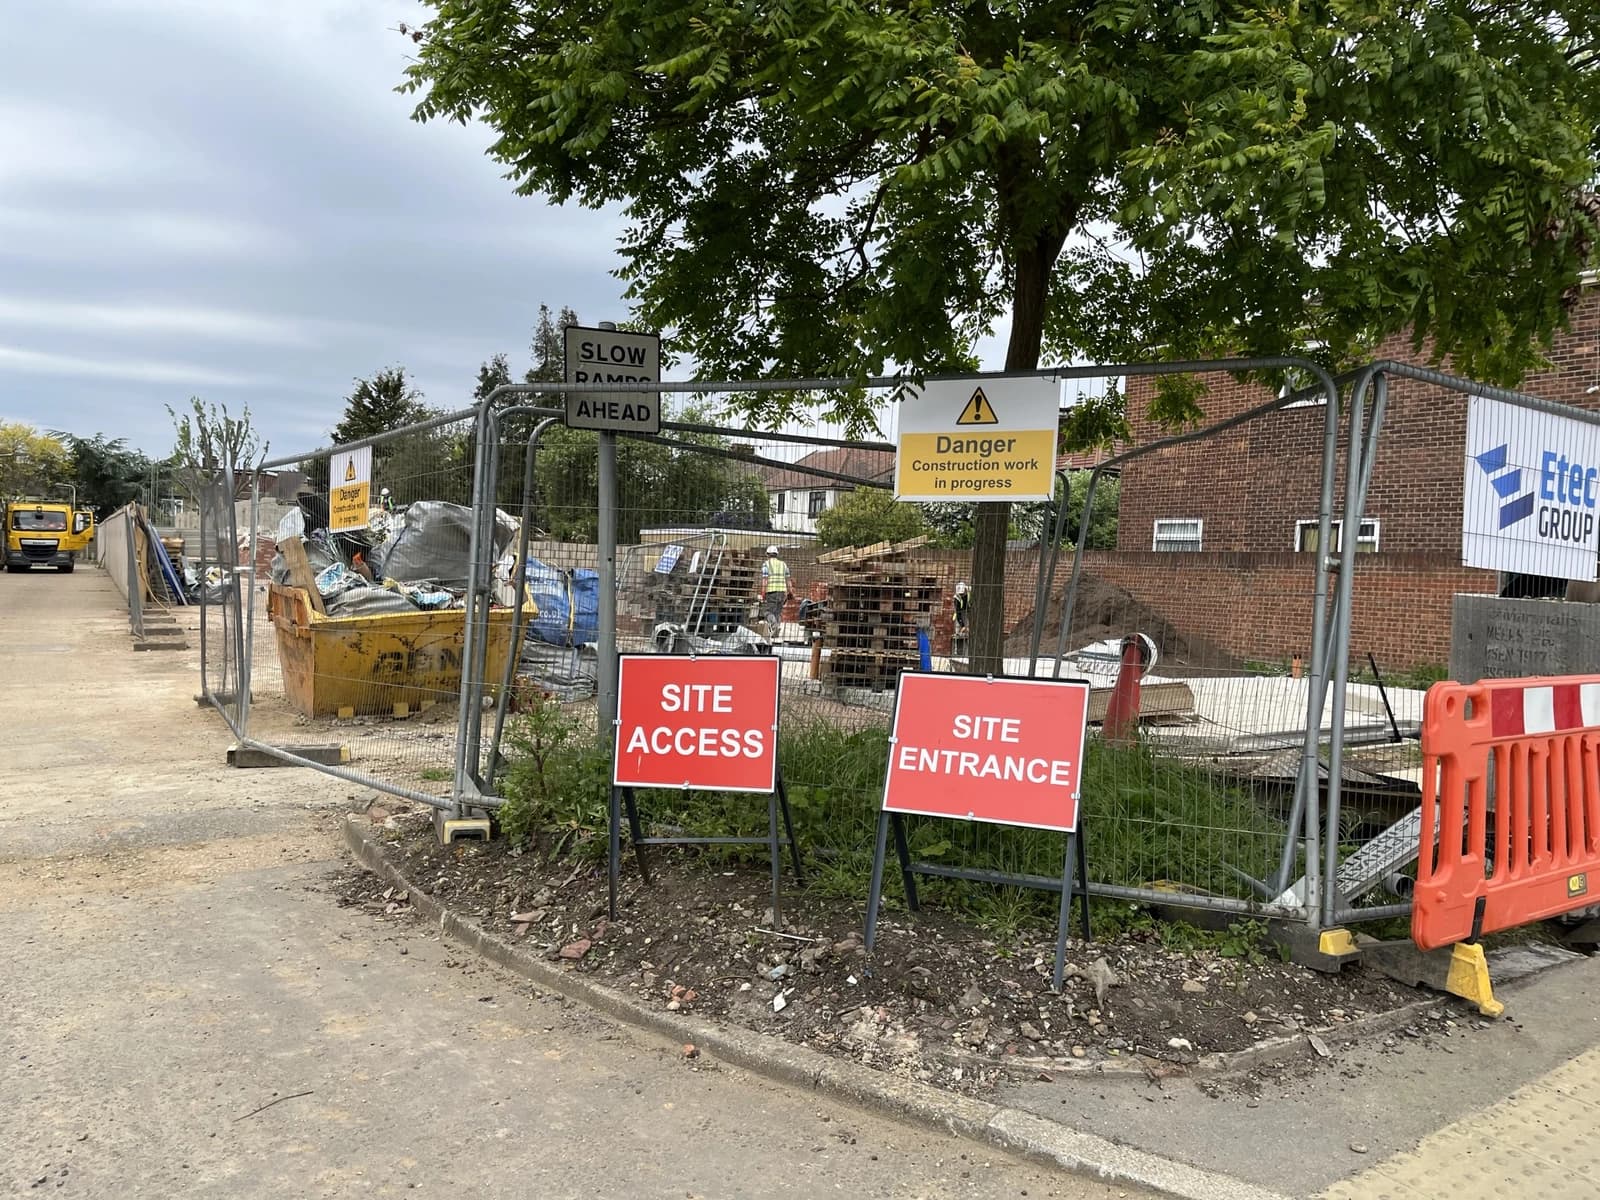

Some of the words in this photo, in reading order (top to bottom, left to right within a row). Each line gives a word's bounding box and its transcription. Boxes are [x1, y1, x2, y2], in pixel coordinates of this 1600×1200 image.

[580, 342, 646, 365] SLOW
[576, 400, 651, 422] AHEAD
[936, 435, 1016, 458] Danger
[912, 459, 999, 471] Construction
[1004, 458, 1039, 470] work
[1540, 450, 1597, 508] Etec
[339, 488, 361, 502] Danger
[934, 477, 946, 489] in
[951, 478, 1012, 491] progress
[1538, 505, 1593, 544] GROUP
[660, 683, 733, 713] SITE
[626, 726, 764, 758] ACCESS
[952, 714, 1021, 743] SITE
[899, 746, 1071, 786] ENTRANCE
[1336, 811, 1422, 877] ESIDENTS
